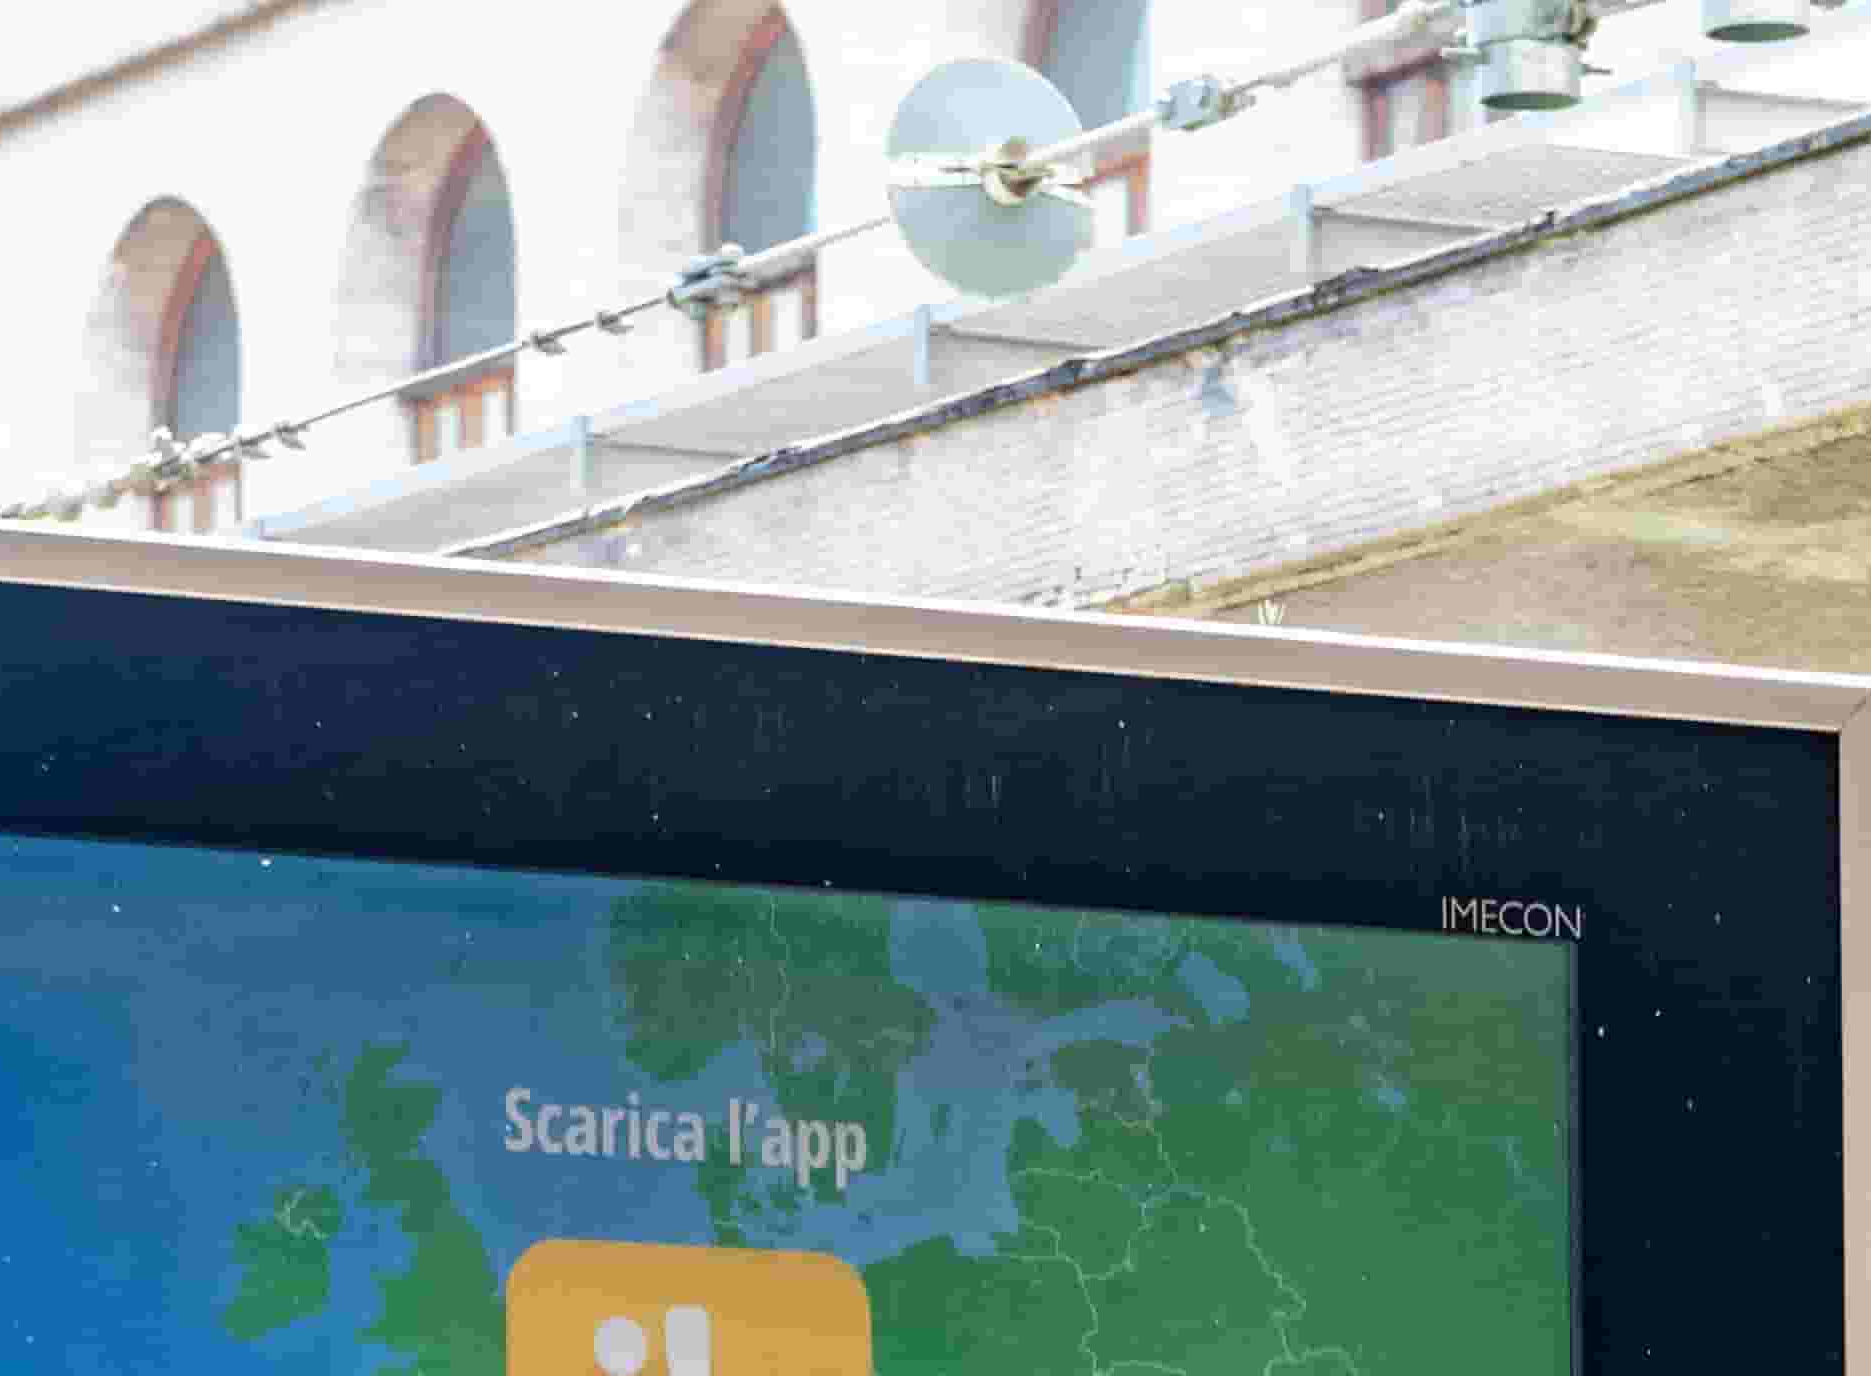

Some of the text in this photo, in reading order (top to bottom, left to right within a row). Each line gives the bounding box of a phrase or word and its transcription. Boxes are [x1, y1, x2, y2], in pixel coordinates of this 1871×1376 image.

[1441, 896, 1581, 938] IMECON
[505, 1088, 867, 1188] Scarica l'app
